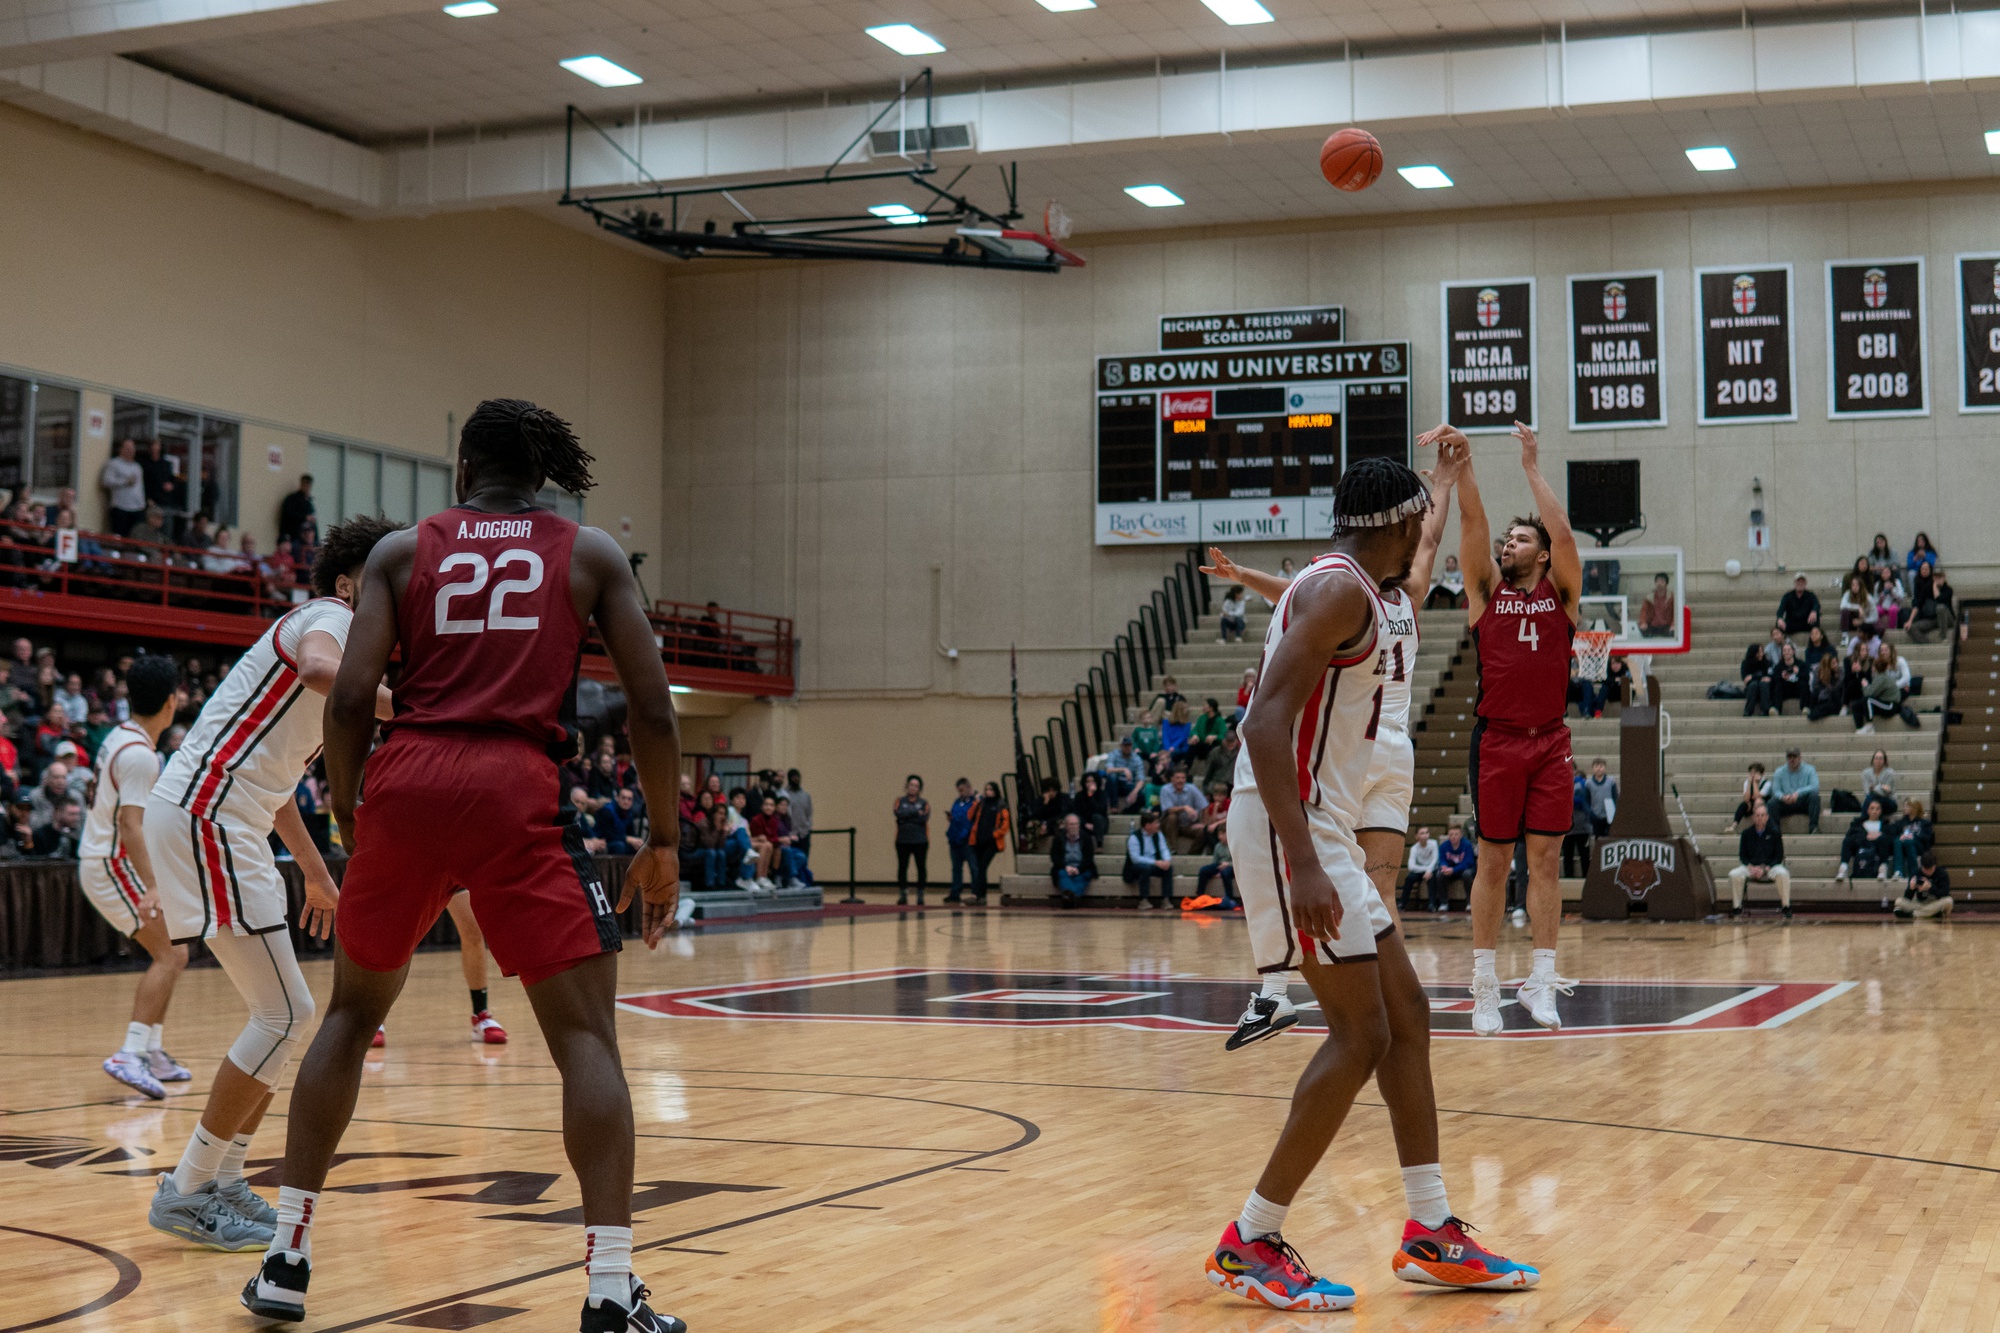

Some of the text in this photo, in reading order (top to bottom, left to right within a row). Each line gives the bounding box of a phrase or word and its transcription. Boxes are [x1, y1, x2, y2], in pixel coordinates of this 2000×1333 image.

[1163, 313, 1339, 333] RICHARD A. FRIEDMAN '79
[1734, 315, 1781, 327] BASKETBALL
[1865, 309, 1911, 321] BASKETBALL
[1203, 329, 1292, 345] SCOREBOARD
[1478, 328, 1523, 340] BASKETBALL
[1605, 322, 1650, 334] BASKETBALL
[1591, 340, 1641, 362] NCAA
[1727, 339, 1765, 365] NIT
[1857, 333, 1897, 360] CBI
[1464, 346, 1513, 367] NCAA
[1129, 361, 1219, 384] BROWN
[1228, 352, 1373, 379] UNIVERSITY
[1450, 365, 1529, 384] TOURNAMENT
[1576, 359, 1657, 378] TOURNAMENT
[1717, 378, 1778, 405] 2003
[1848, 372, 1909, 400] 2008
[1462, 389, 1517, 416] 1939
[1590, 384, 1645, 410] 1986
[1173, 419, 1206, 433] BROWN
[1237, 423, 1264, 434] PERIOD
[1288, 413, 1333, 429] HARVARD
[1168, 460, 1192, 471] FOULS
[1227, 457, 1274, 468] FOUL PLAYER
[1310, 454, 1334, 465] FOULS
[1230, 487, 1272, 498] ADVANTAGE
[457, 520, 533, 540] AJOGBOR
[1109, 512, 1186, 534] BayCoast
[1213, 519, 1288, 536] SHAWMUT
[435, 548, 544, 636] 22
[1495, 598, 1556, 615] HARVARD
[1518, 618, 1539, 651] 4
[1603, 842, 1673, 868] BROWN
[589, 881, 612, 916] H
[1447, 1244, 1464, 1259] 13
